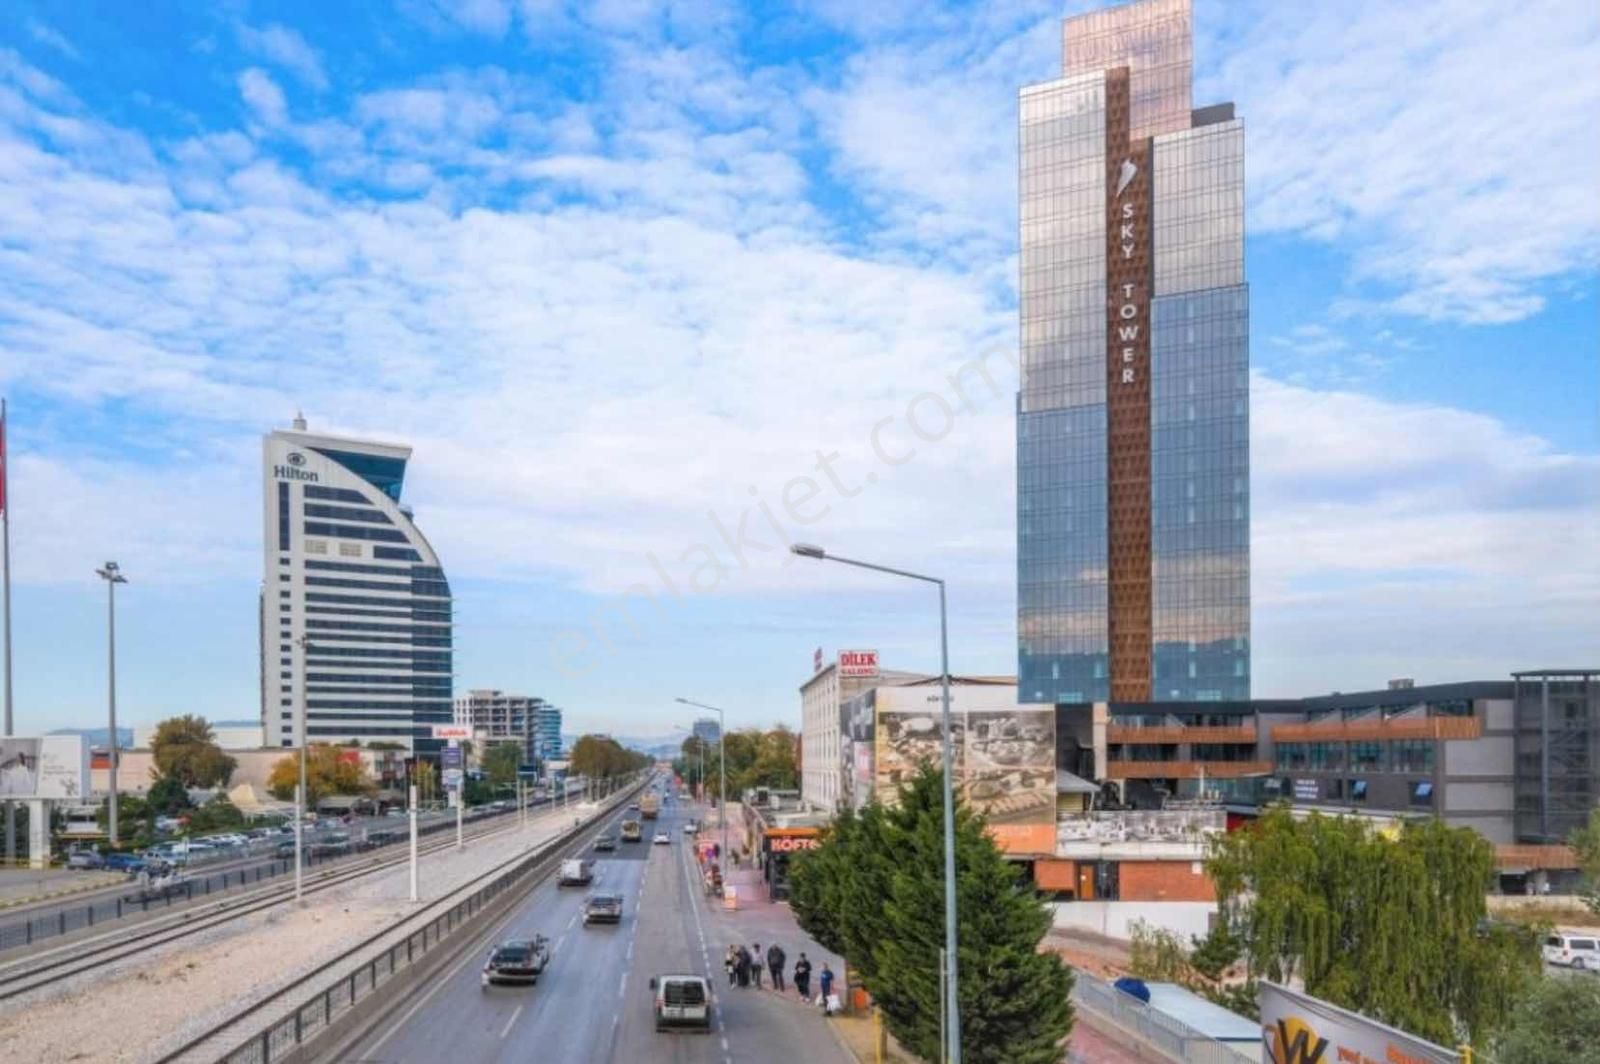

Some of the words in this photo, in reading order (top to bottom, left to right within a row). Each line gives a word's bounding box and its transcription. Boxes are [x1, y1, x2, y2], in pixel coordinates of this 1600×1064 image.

[1120, 203, 1134, 259] SKY
[1118, 284, 1139, 384] TOWER
[274, 465, 319, 482] Hilton
[841, 651, 876, 666] DİLEK
